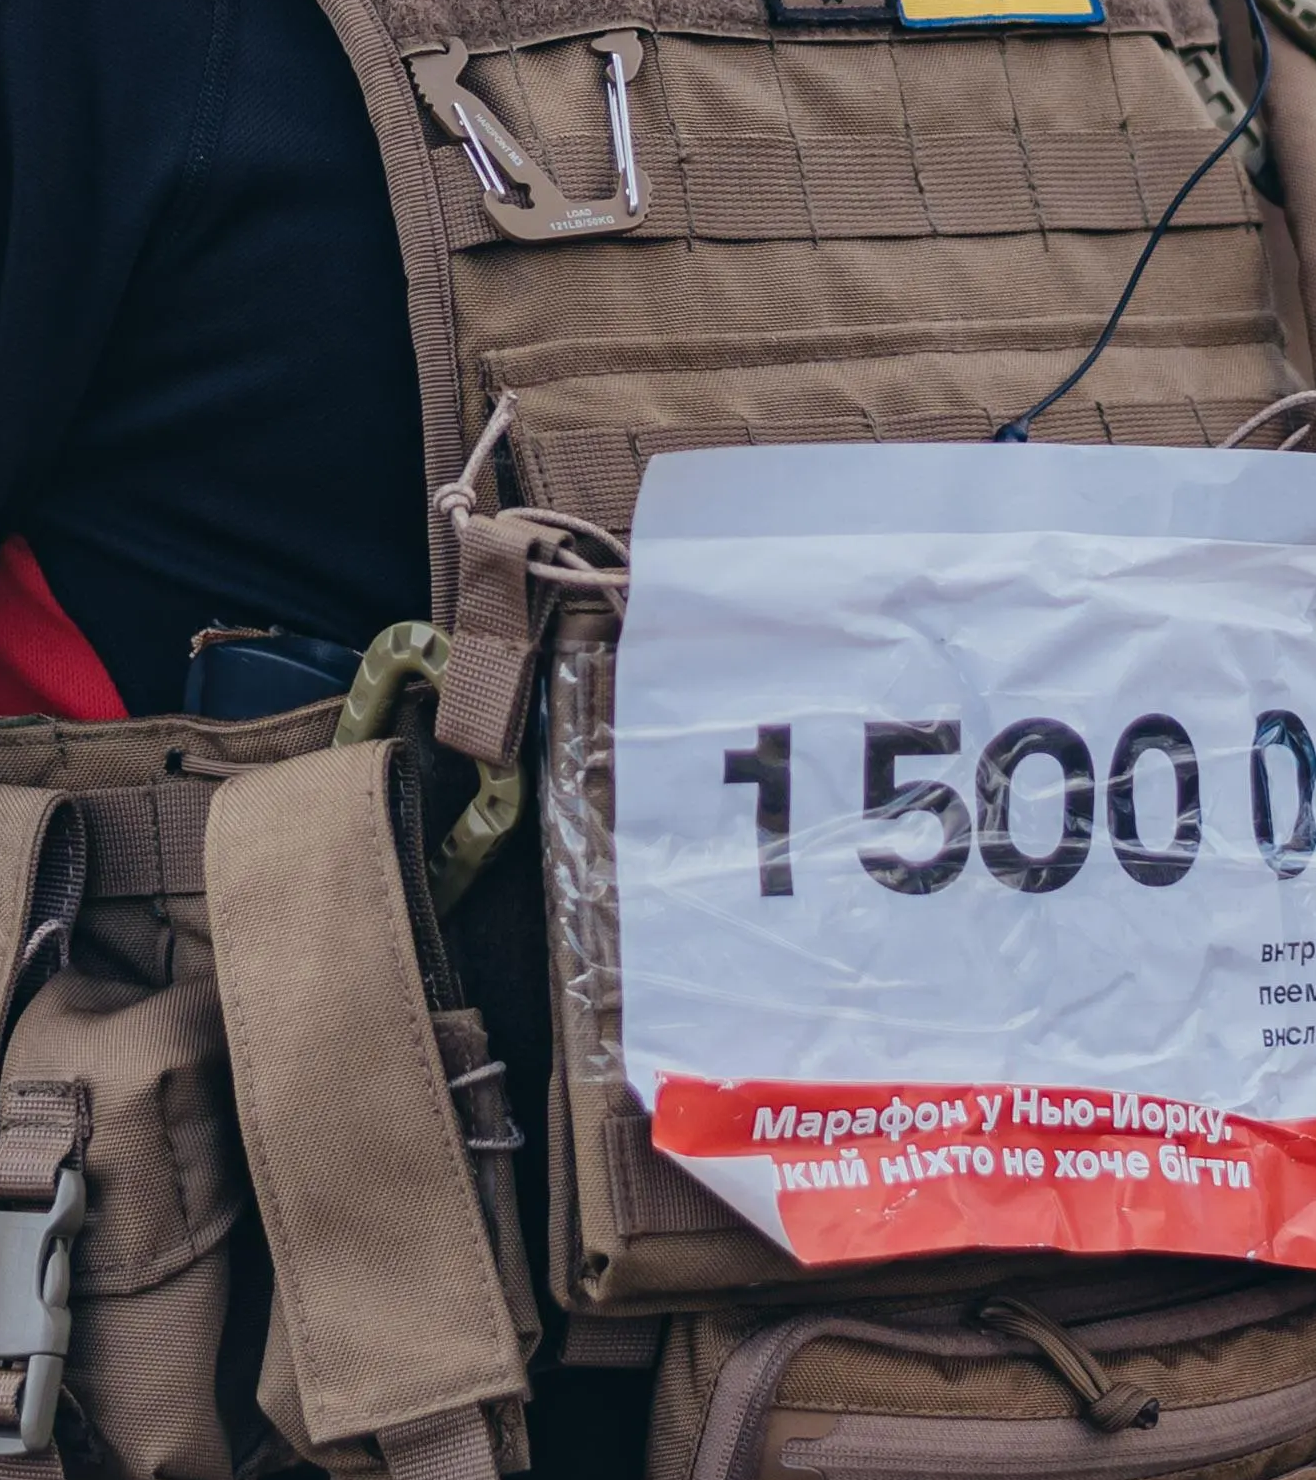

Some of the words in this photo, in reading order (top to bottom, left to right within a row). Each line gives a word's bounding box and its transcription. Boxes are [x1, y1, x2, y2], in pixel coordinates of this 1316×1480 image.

[565, 208, 592, 219] LOAD
[724, 723, 794, 897] 1
[857, 713, 1202, 895] 500
[752, 1096, 968, 1146] Марафон
[977, 1095, 1002, 1132] у
[879, 1144, 995, 1185] ніхто
[1003, 1147, 1045, 1177] не
[1054, 1149, 1150, 1179] хоче
[1159, 1144, 1251, 1188] бігти
